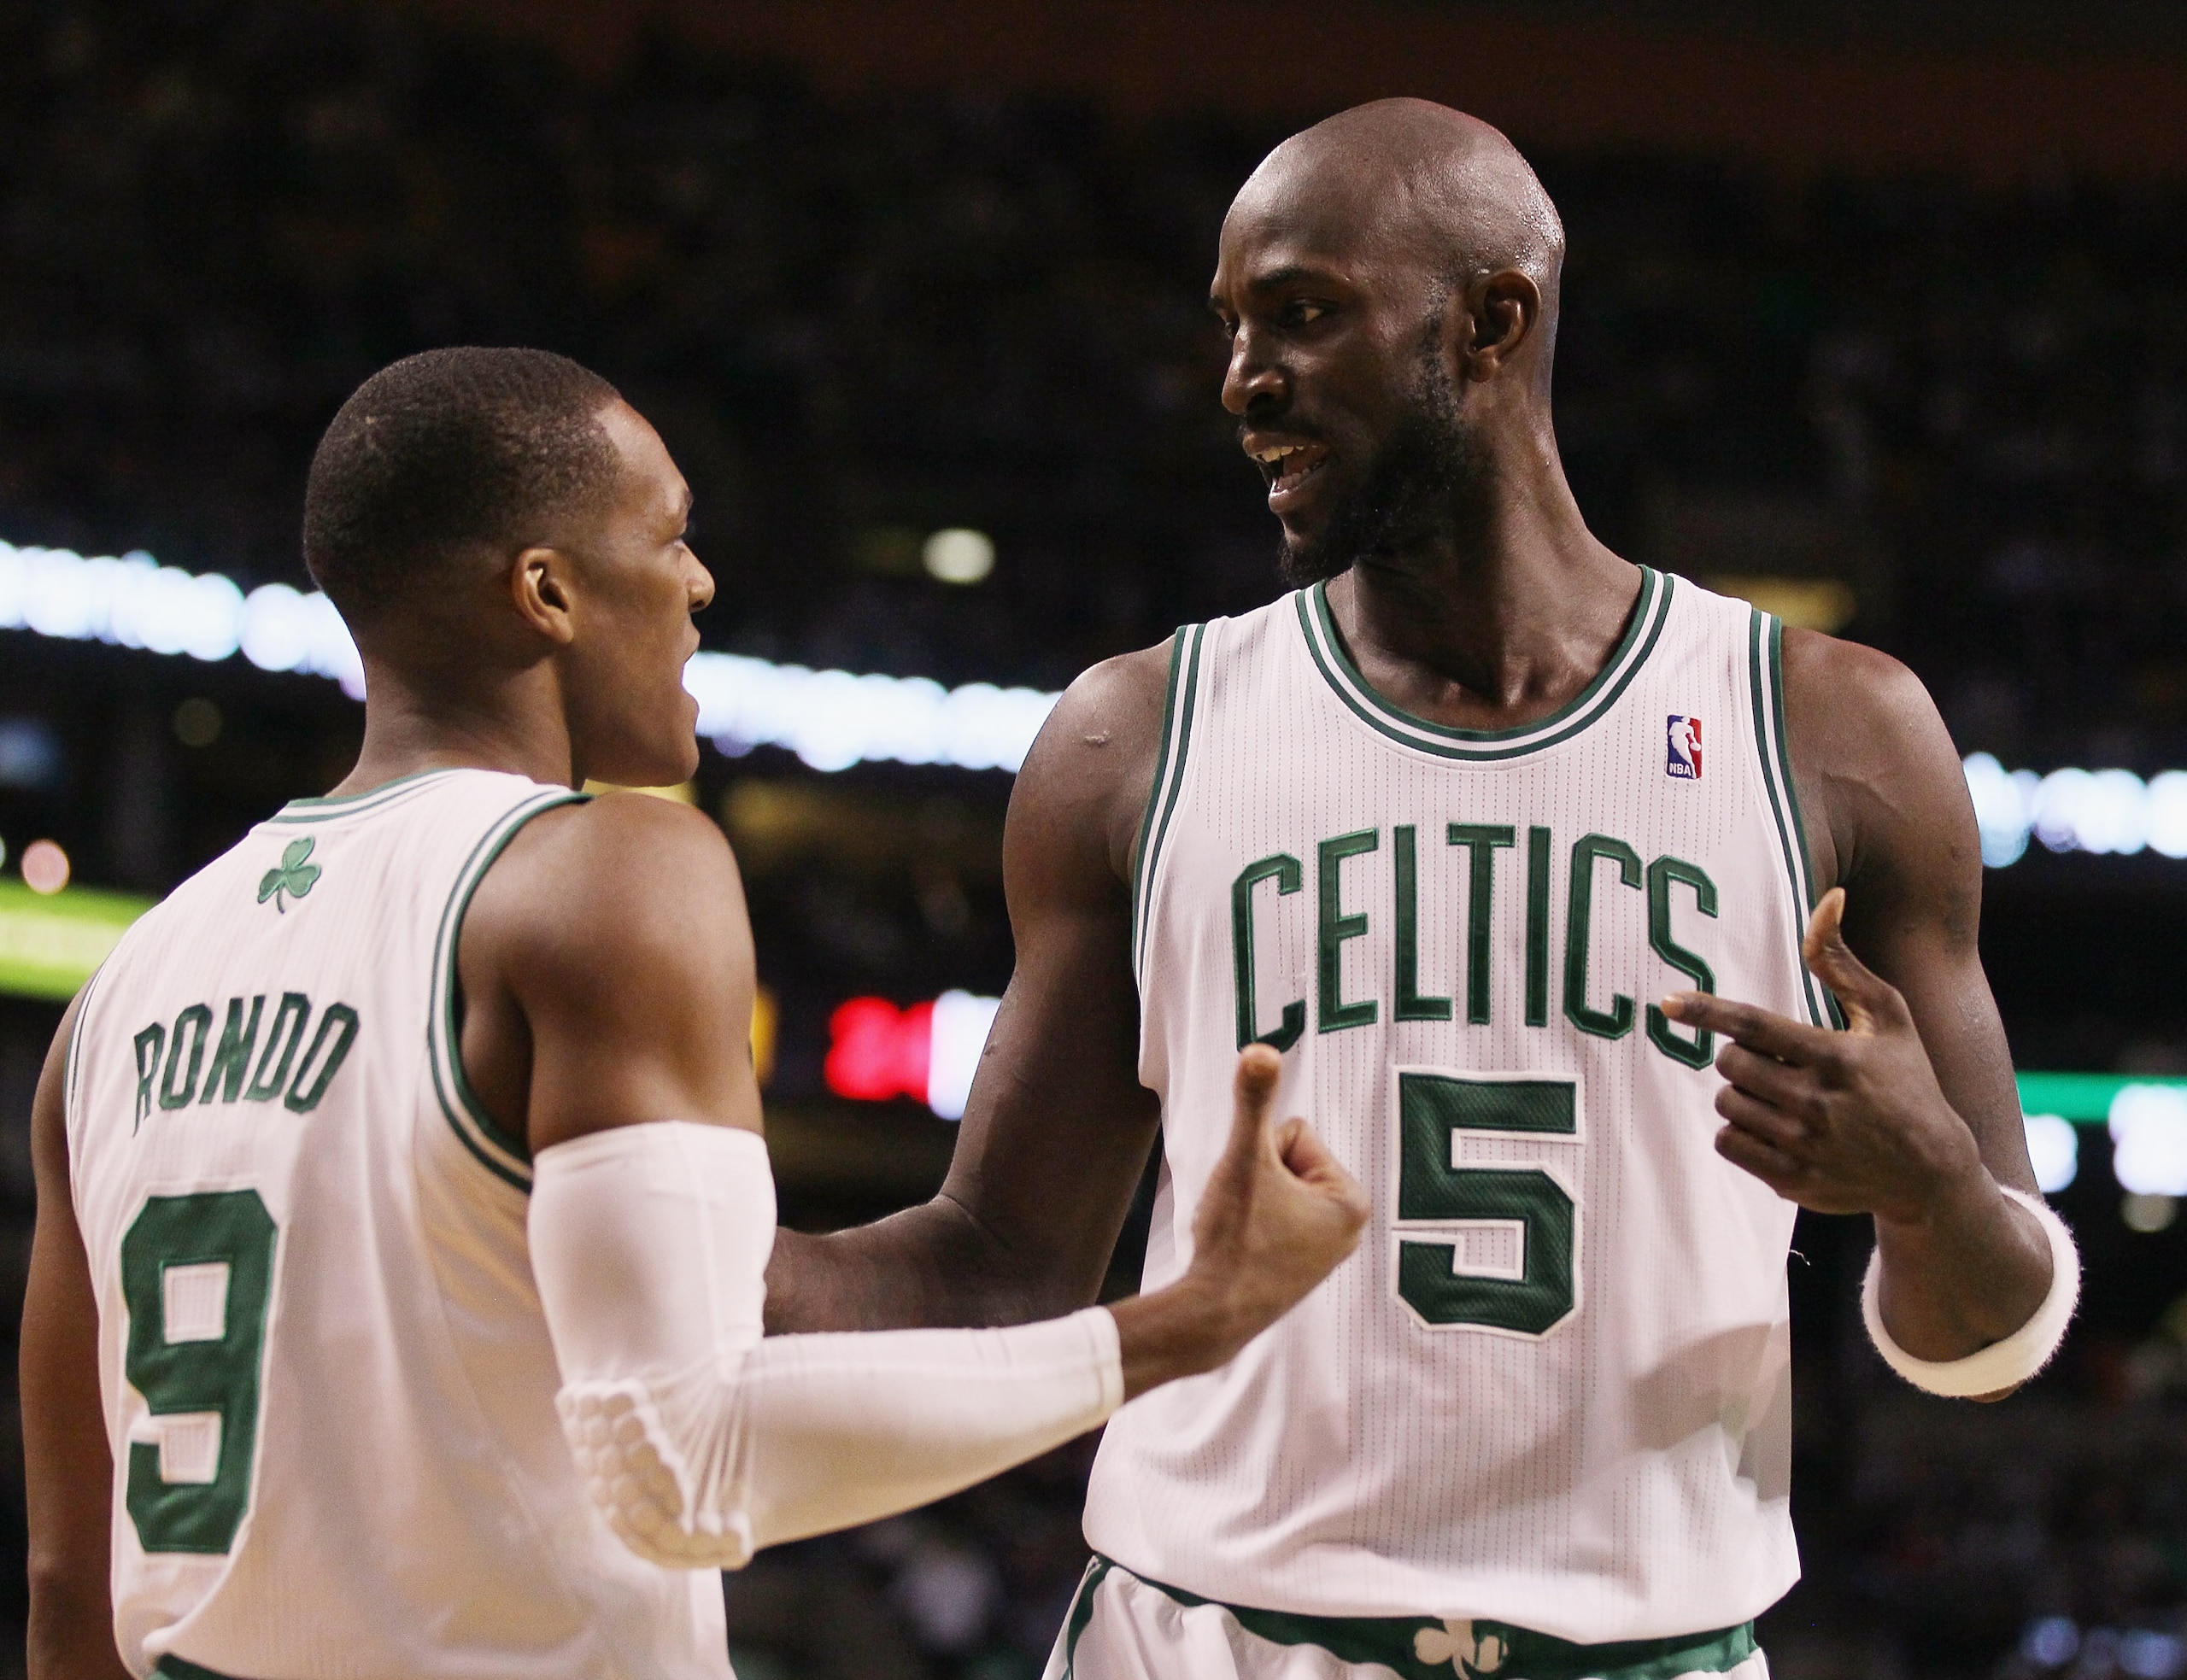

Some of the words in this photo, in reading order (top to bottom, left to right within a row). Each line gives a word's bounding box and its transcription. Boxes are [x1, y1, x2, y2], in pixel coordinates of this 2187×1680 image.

[1669, 763, 1692, 776] NBA
[132, 990, 360, 1139] RONDO
[1232, 822, 1718, 1071] CELTICS
[1397, 1070, 1578, 1336] 5
[120, 1187, 279, 1555] 9
